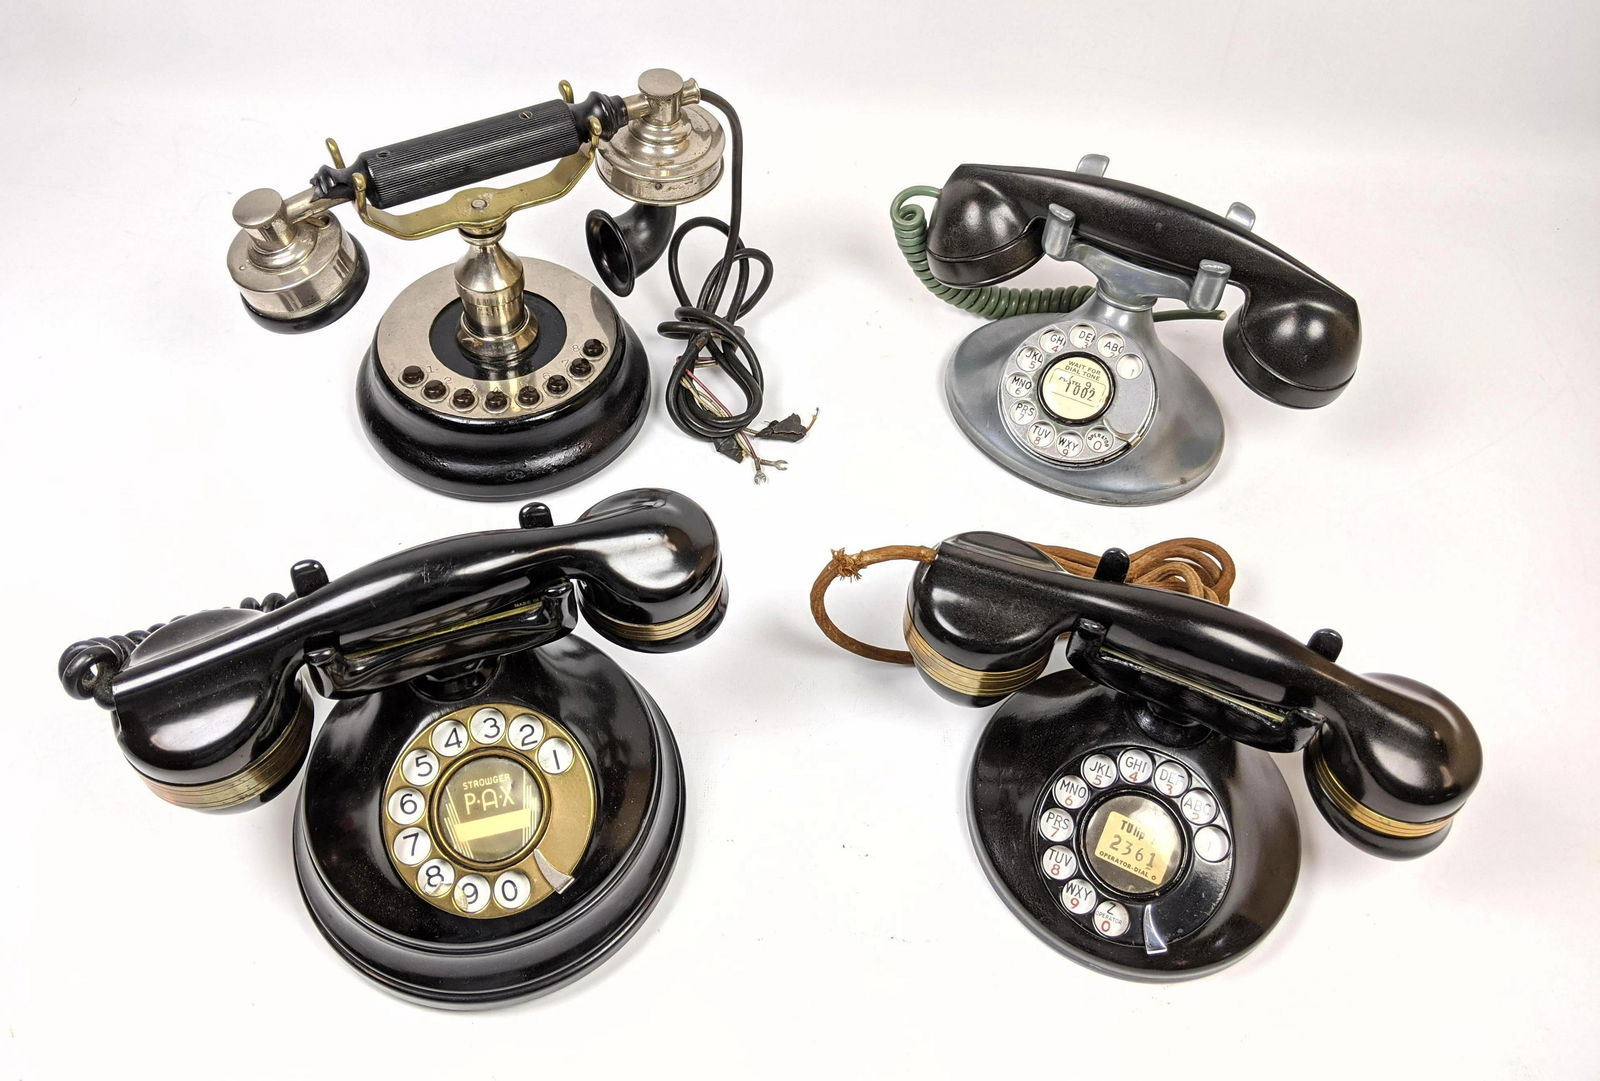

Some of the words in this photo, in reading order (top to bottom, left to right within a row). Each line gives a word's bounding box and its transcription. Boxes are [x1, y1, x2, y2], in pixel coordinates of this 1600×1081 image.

[1029, 361, 1036, 369] 5
[1065, 365, 1080, 375] DIAL
[1083, 371, 1100, 382] TONE
[1069, 361, 1086, 370] WAIT
[1011, 376, 1032, 389] MNO
[1016, 403, 1035, 416] PRS
[1033, 425, 1051, 439] TUV
[1033, 437, 1041, 445] 8
[1058, 436, 1079, 450] WXY
[1062, 448, 1069, 457] 9
[483, 717, 500, 738] 3
[519, 724, 538, 747] 2
[444, 727, 463, 749] 4
[415, 754, 433, 777] 5
[552, 749, 561, 770] 1
[1125, 756, 1147, 773] GHI
[1089, 762, 1112, 779] JKL
[1129, 772, 1138, 783] 4
[462, 773, 511, 790] STROWGER
[1059, 779, 1086, 798] MNO
[1092, 775, 1102, 786] 5
[1166, 784, 1173, 796] 3
[400, 793, 418, 815] 6
[1065, 795, 1073, 806] 6
[1046, 812, 1070, 830] PRS
[1050, 826, 1060, 838] 7
[402, 832, 420, 857] 7
[1109, 834, 1156, 868] 2361
[1049, 849, 1073, 867] TUV
[425, 865, 445, 888] 8
[1051, 864, 1060, 876] 8
[461, 882, 479, 905] 9
[501, 879, 518, 901] 0
[1065, 882, 1093, 901] WXY
[1070, 898, 1080, 910] 9
[1106, 903, 1117, 916] Z
[1095, 911, 1122, 925] OPERATOR
[1101, 920, 1110, 932] 0
